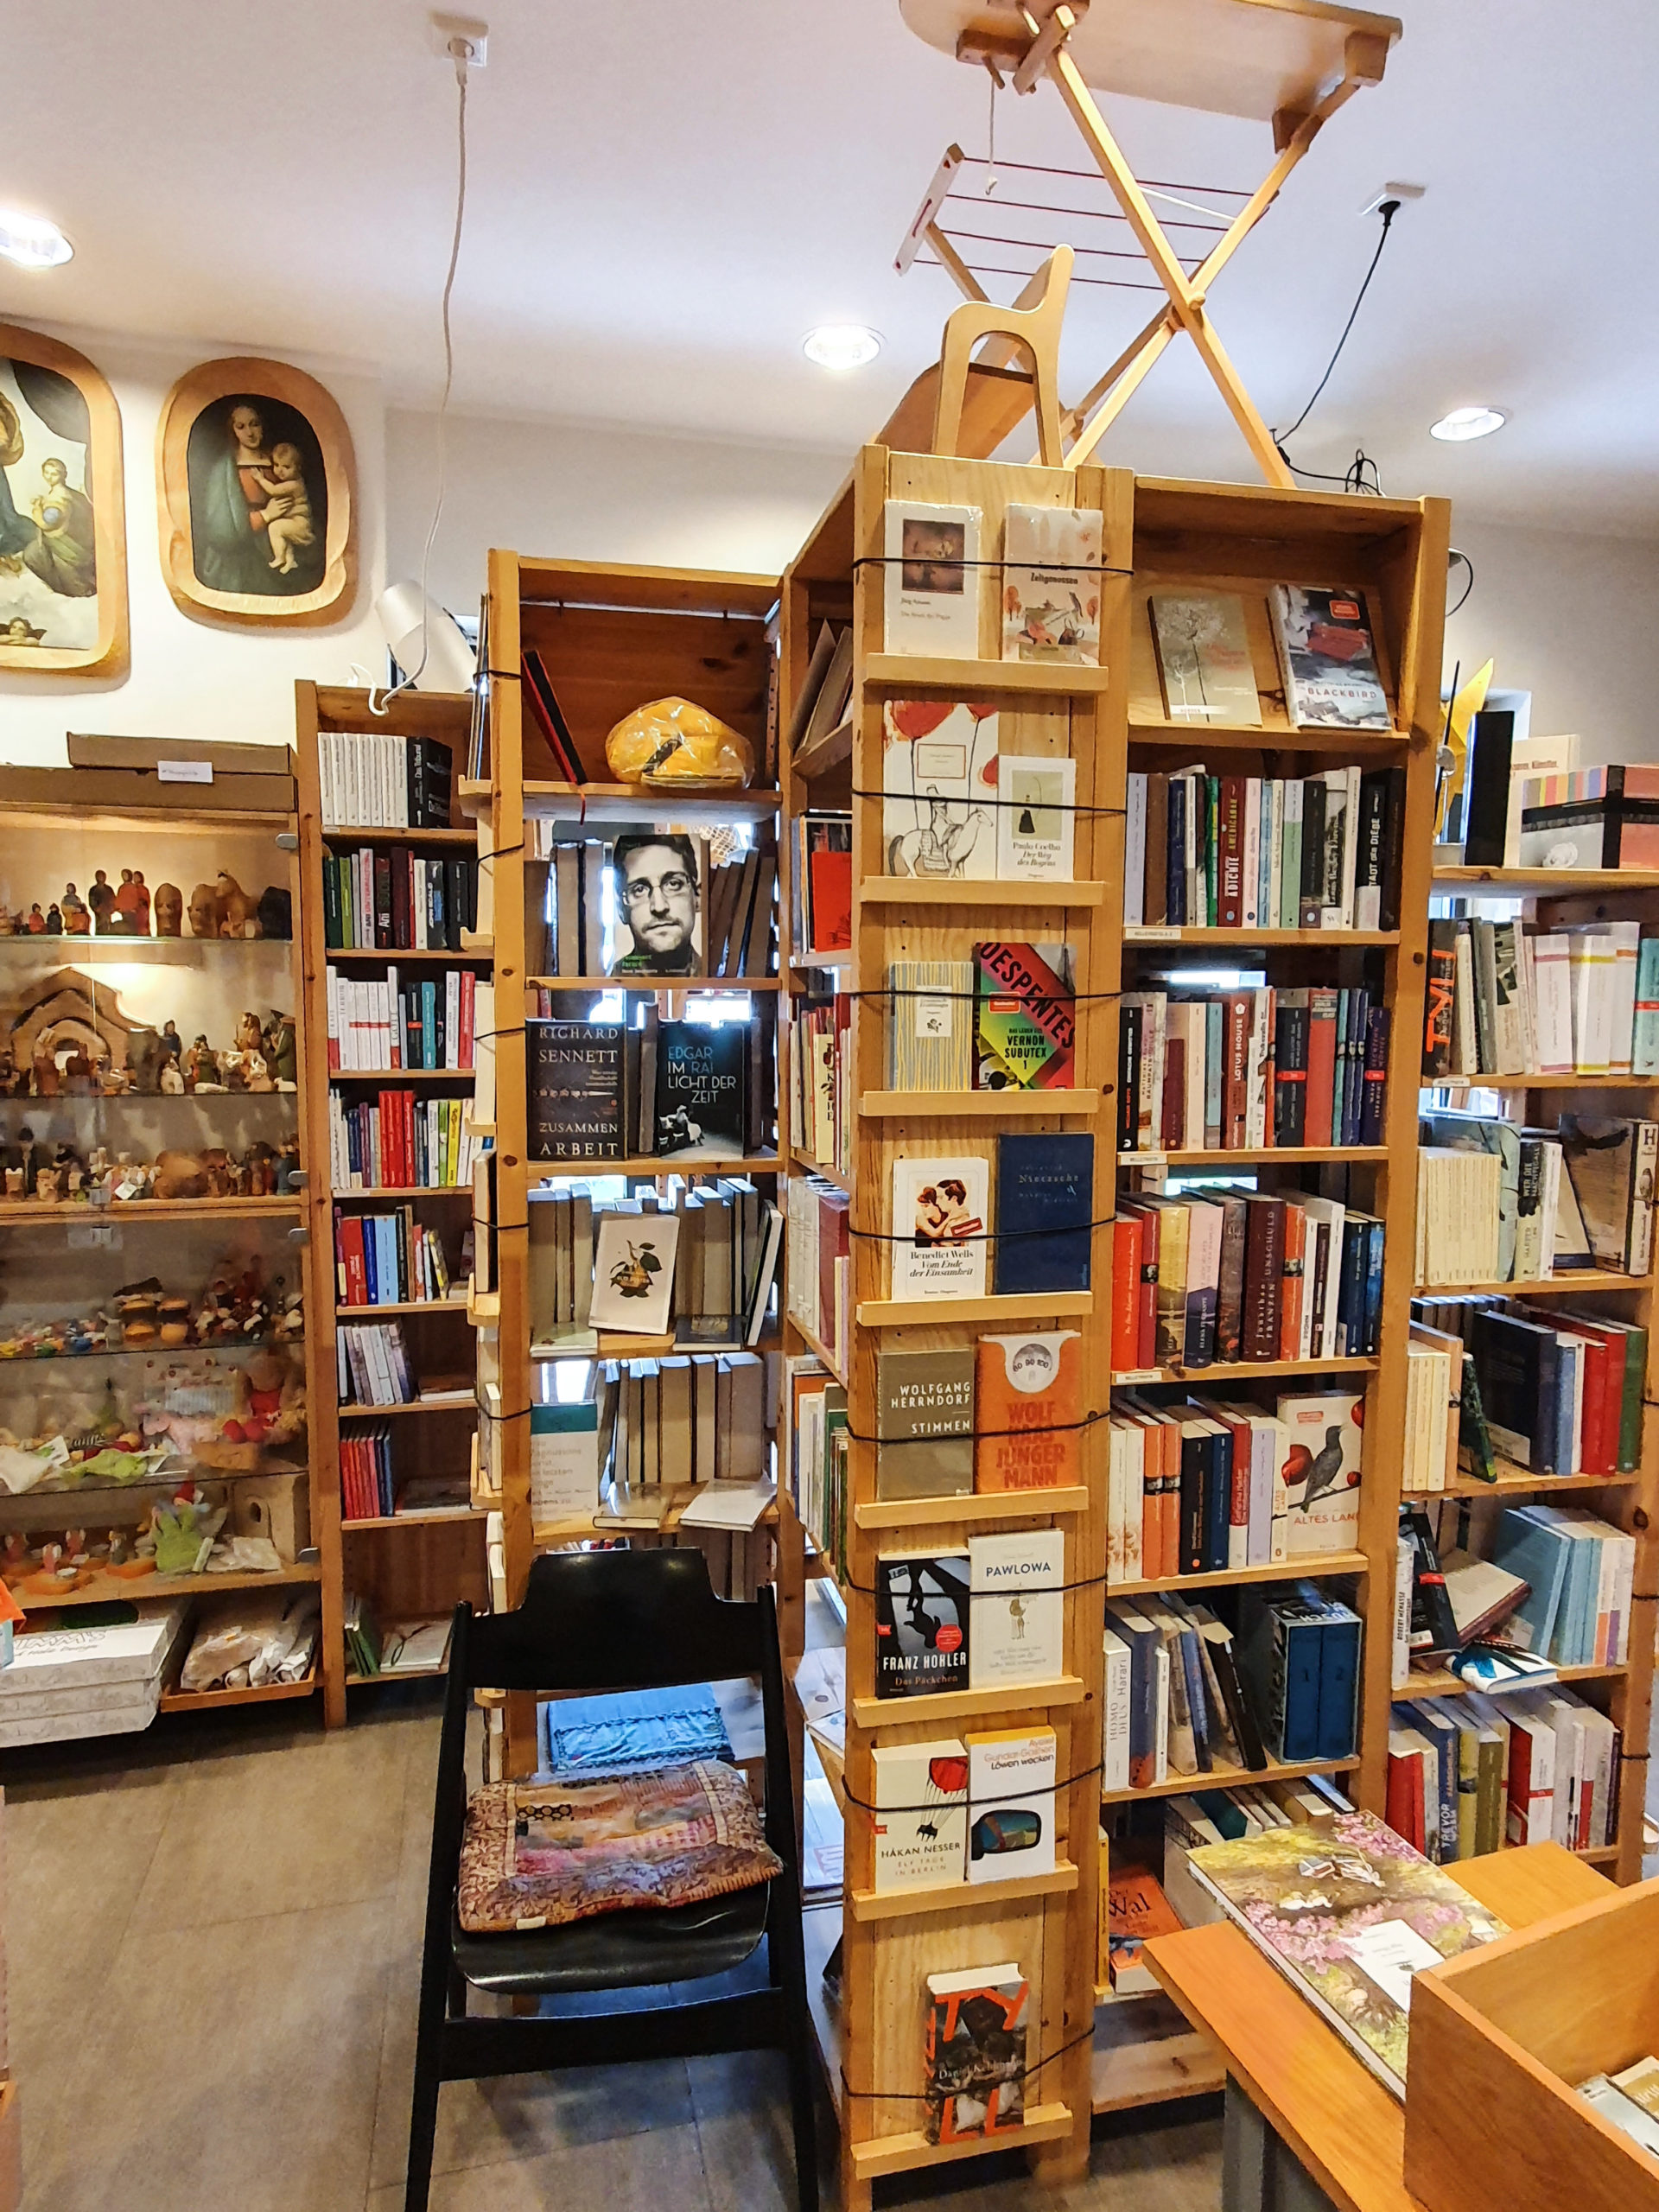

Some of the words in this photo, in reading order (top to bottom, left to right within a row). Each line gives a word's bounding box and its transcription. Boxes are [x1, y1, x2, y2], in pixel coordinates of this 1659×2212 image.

[1307, 687, 1377, 699] BLACKBIRD
[1013, 842, 1033, 850] Paulo
[1034, 842, 1061, 851] Coelho
[1227, 856, 1239, 898] ADICHIE
[1369, 863, 1379, 887] TADT
[980, 942, 1076, 1049] DESPENTES
[539, 1027, 619, 1040] RICHARD
[1007, 1035, 1045, 1046] VERNON
[1235, 1019, 1243, 1051] HOUSE
[538, 1050, 618, 1064] SENNETT
[668, 1046, 714, 1059] EDGAR
[1005, 1047, 1047, 1058] SUBUTEX
[667, 1061, 685, 1075] IM
[1023, 1059, 1027, 1070] 1
[1234, 1052, 1243, 1081] LOTUS
[668, 1075, 708, 1090] LICHT
[711, 1075, 737, 1089] DER
[691, 1090, 718, 1103] ZEIT
[539, 1122, 619, 1134] ZUSAMMEN
[1643, 1128, 1656, 1146] H
[539, 1142, 619, 1156] ARBEIT
[1265, 1211, 1275, 1276] UNSCHULD
[910, 1250, 949, 1260] Benedict
[950, 1249, 974, 1259] Wells
[940, 1260, 963, 1268] Ende
[910, 1268, 925, 1277] der
[925, 1268, 973, 1277] Einsamkeit
[1266, 1283, 1276, 1338] FRANZEN
[899, 1382, 971, 1396] WOLFGANG
[891, 1394, 971, 1408] HERRNDORF
[1007, 1401, 1055, 1424] WOLF
[912, 1420, 971, 1434] STIMMEN
[997, 1444, 1065, 1468] JUNGER
[1004, 1466, 1058, 1488] MANN
[1294, 1515, 1329, 1525] ALTES
[986, 1561, 1052, 1577] PAWLOWA
[883, 1655, 918, 1671] FRANZ
[923, 1651, 967, 1669] HOHLER
[1116, 1658, 1128, 1696] Harari
[1109, 1701, 1118, 1741] HOMO
[1440, 1803, 1450, 1847] TREVOR
[881, 1844, 920, 1859] HÅKAN
[924, 1841, 961, 1854] NESSER
[911, 1864, 946, 1875] BERLIN
[935, 1979, 1030, 2043] TY
